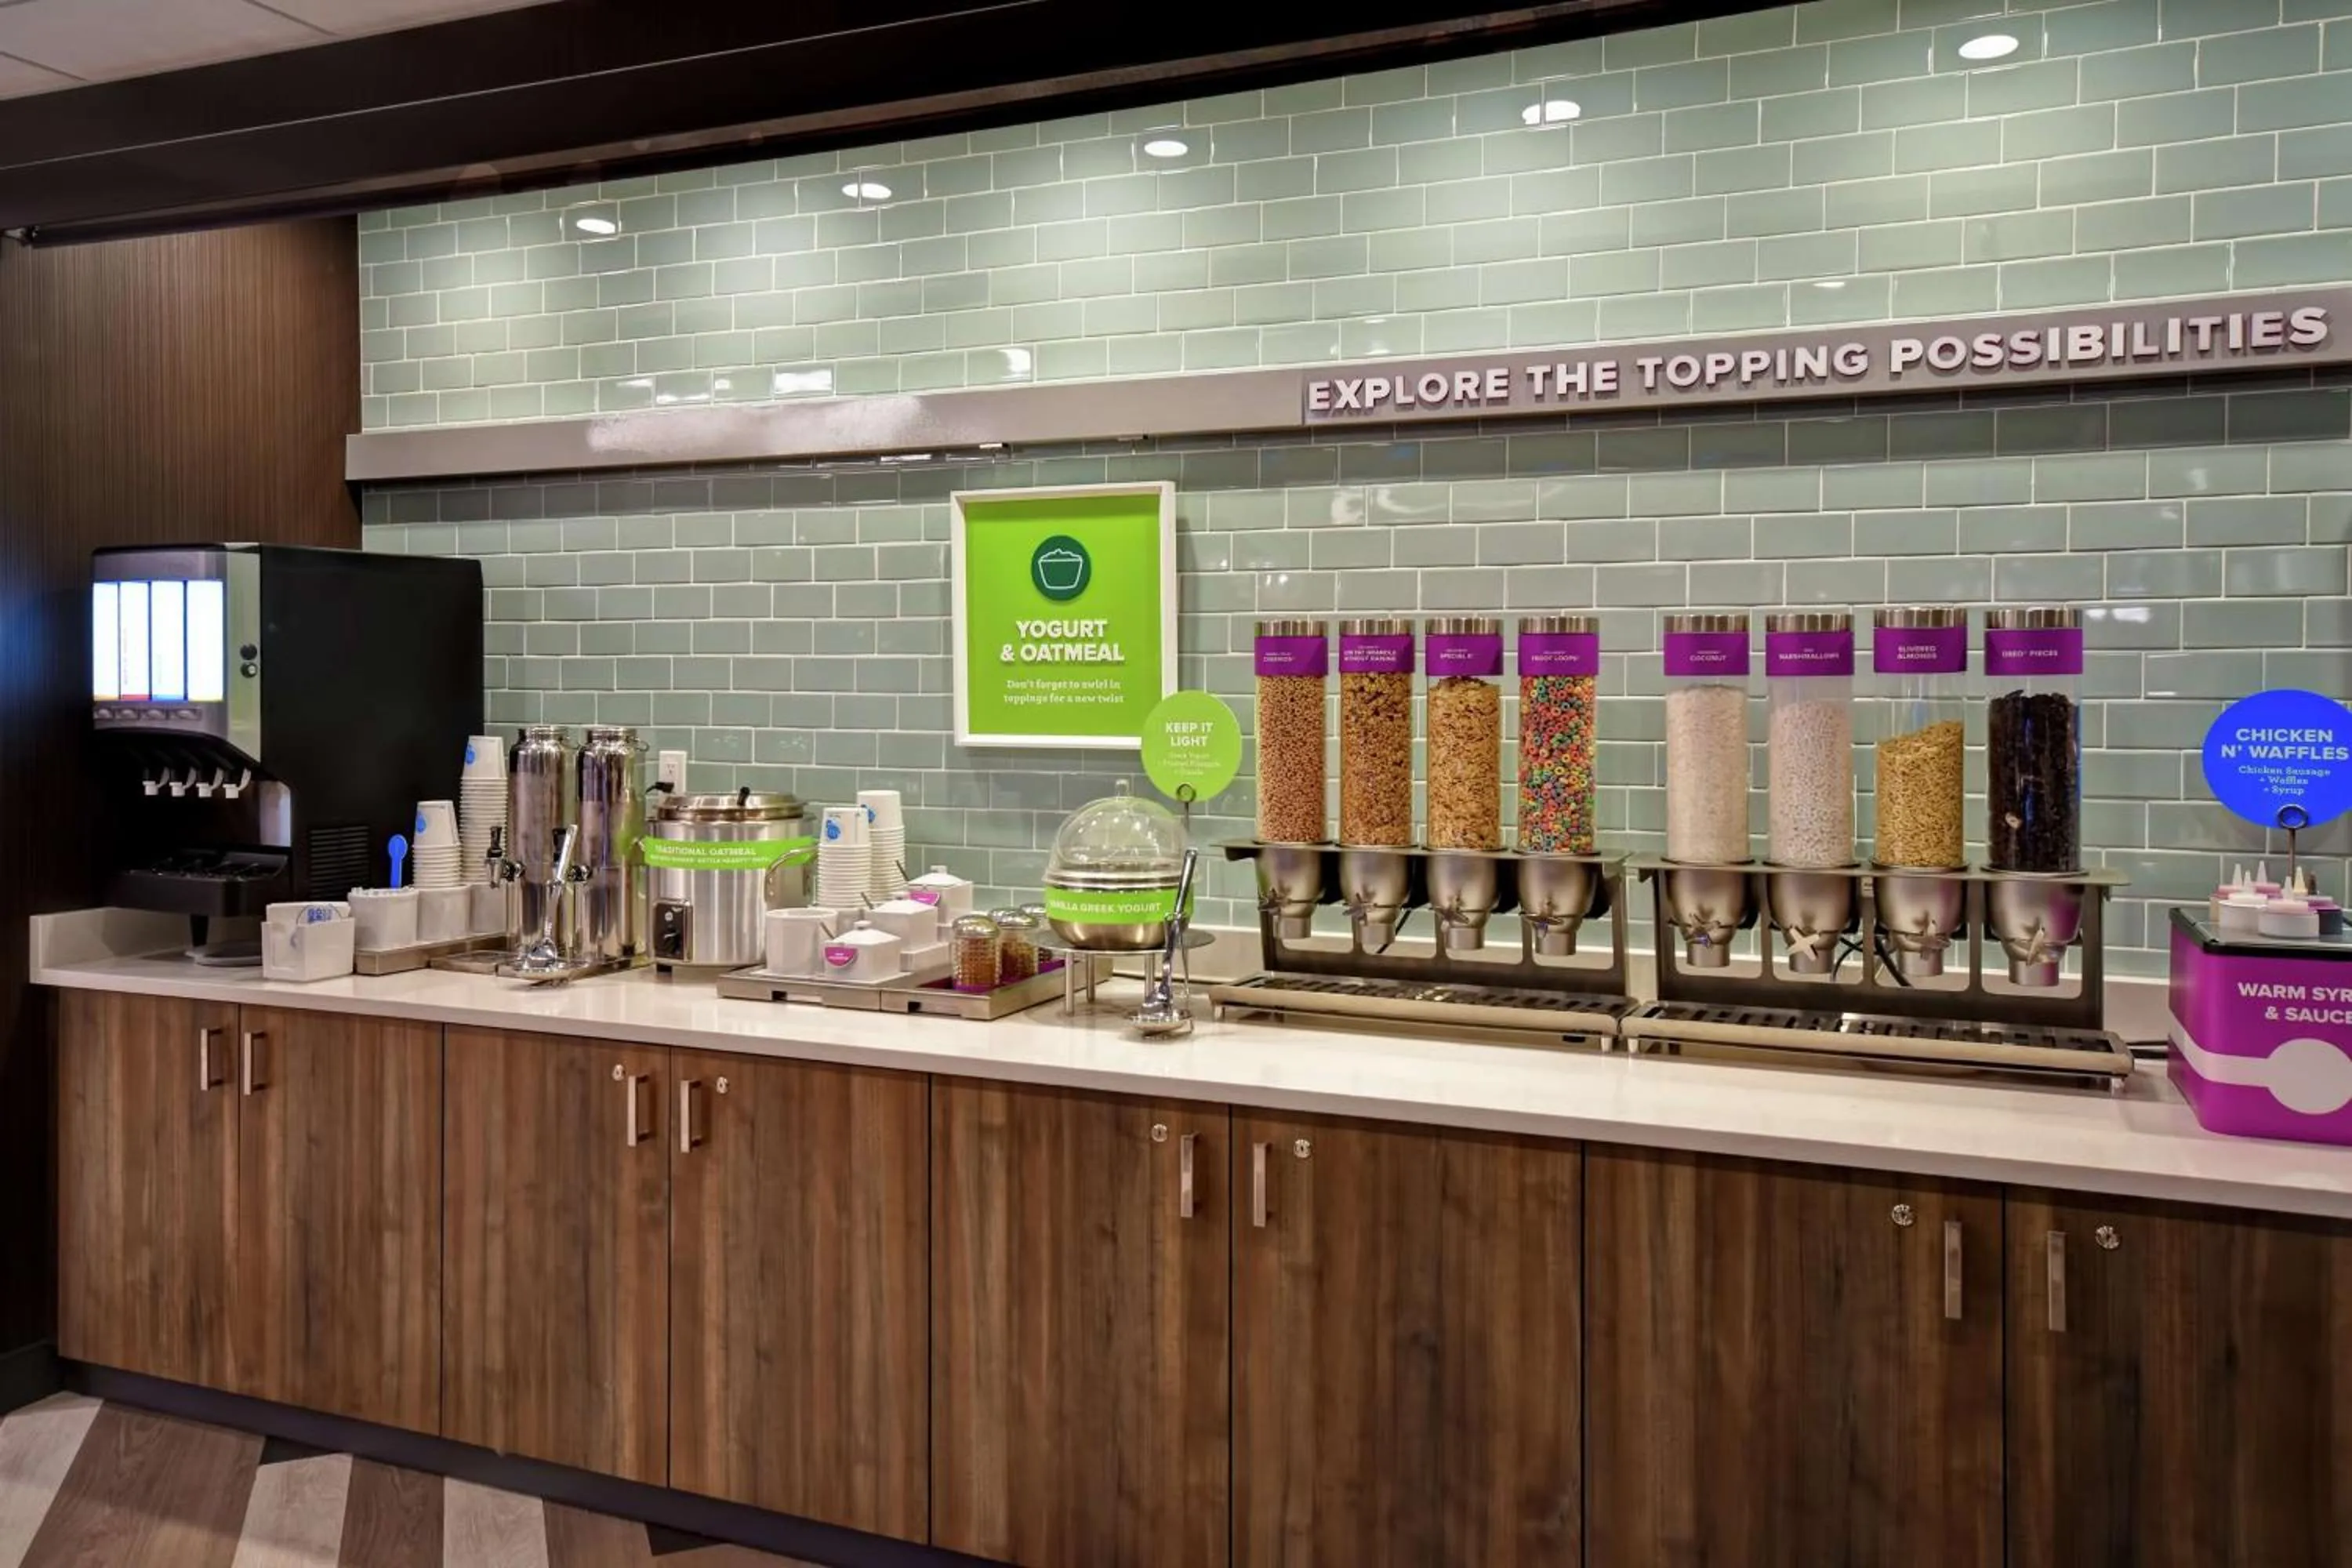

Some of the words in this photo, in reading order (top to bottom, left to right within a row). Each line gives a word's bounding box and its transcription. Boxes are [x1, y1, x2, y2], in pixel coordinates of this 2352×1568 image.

[1308, 367, 1511, 411] EXPLORE
[1526, 360, 1618, 396] THE
[1636, 342, 1869, 389] TOPPING
[1889, 307, 2328, 374] POSSIBILITIES
[1016, 619, 1109, 639] YOGURT
[1000, 644, 1015, 662] &
[1020, 642, 1125, 662] OATMEAL
[1007, 679, 1034, 689] Don't
[1036, 678, 1068, 691] forget
[1069, 681, 1080, 689] to
[1081, 679, 1108, 689] swirl
[1109, 679, 1121, 689] in
[1003, 693, 1048, 705] toppings
[1049, 692, 1066, 703] for
[1075, 695, 1096, 703] new
[1098, 694, 1124, 703] twist
[1166, 721, 1198, 733] KEEP
[1201, 721, 1214, 733] IT
[1171, 735, 1208, 747] LIGHT
[2235, 728, 2334, 742] CHICKEN
[2220, 743, 2243, 759] N'
[2248, 745, 2350, 760] WAFFLES
[2238, 765, 2283, 775] Chicken
[2285, 766, 2331, 777] Sausage
[2267, 775, 2309, 785] Waffles
[2271, 785, 2305, 796] Syrup
[709, 847, 757, 856] OATMEAL
[1080, 902, 1115, 913] GREEK
[1118, 902, 1162, 913] YOGURT
[2237, 982, 2306, 1000] WARM
[2264, 1006, 2279, 1020] &
